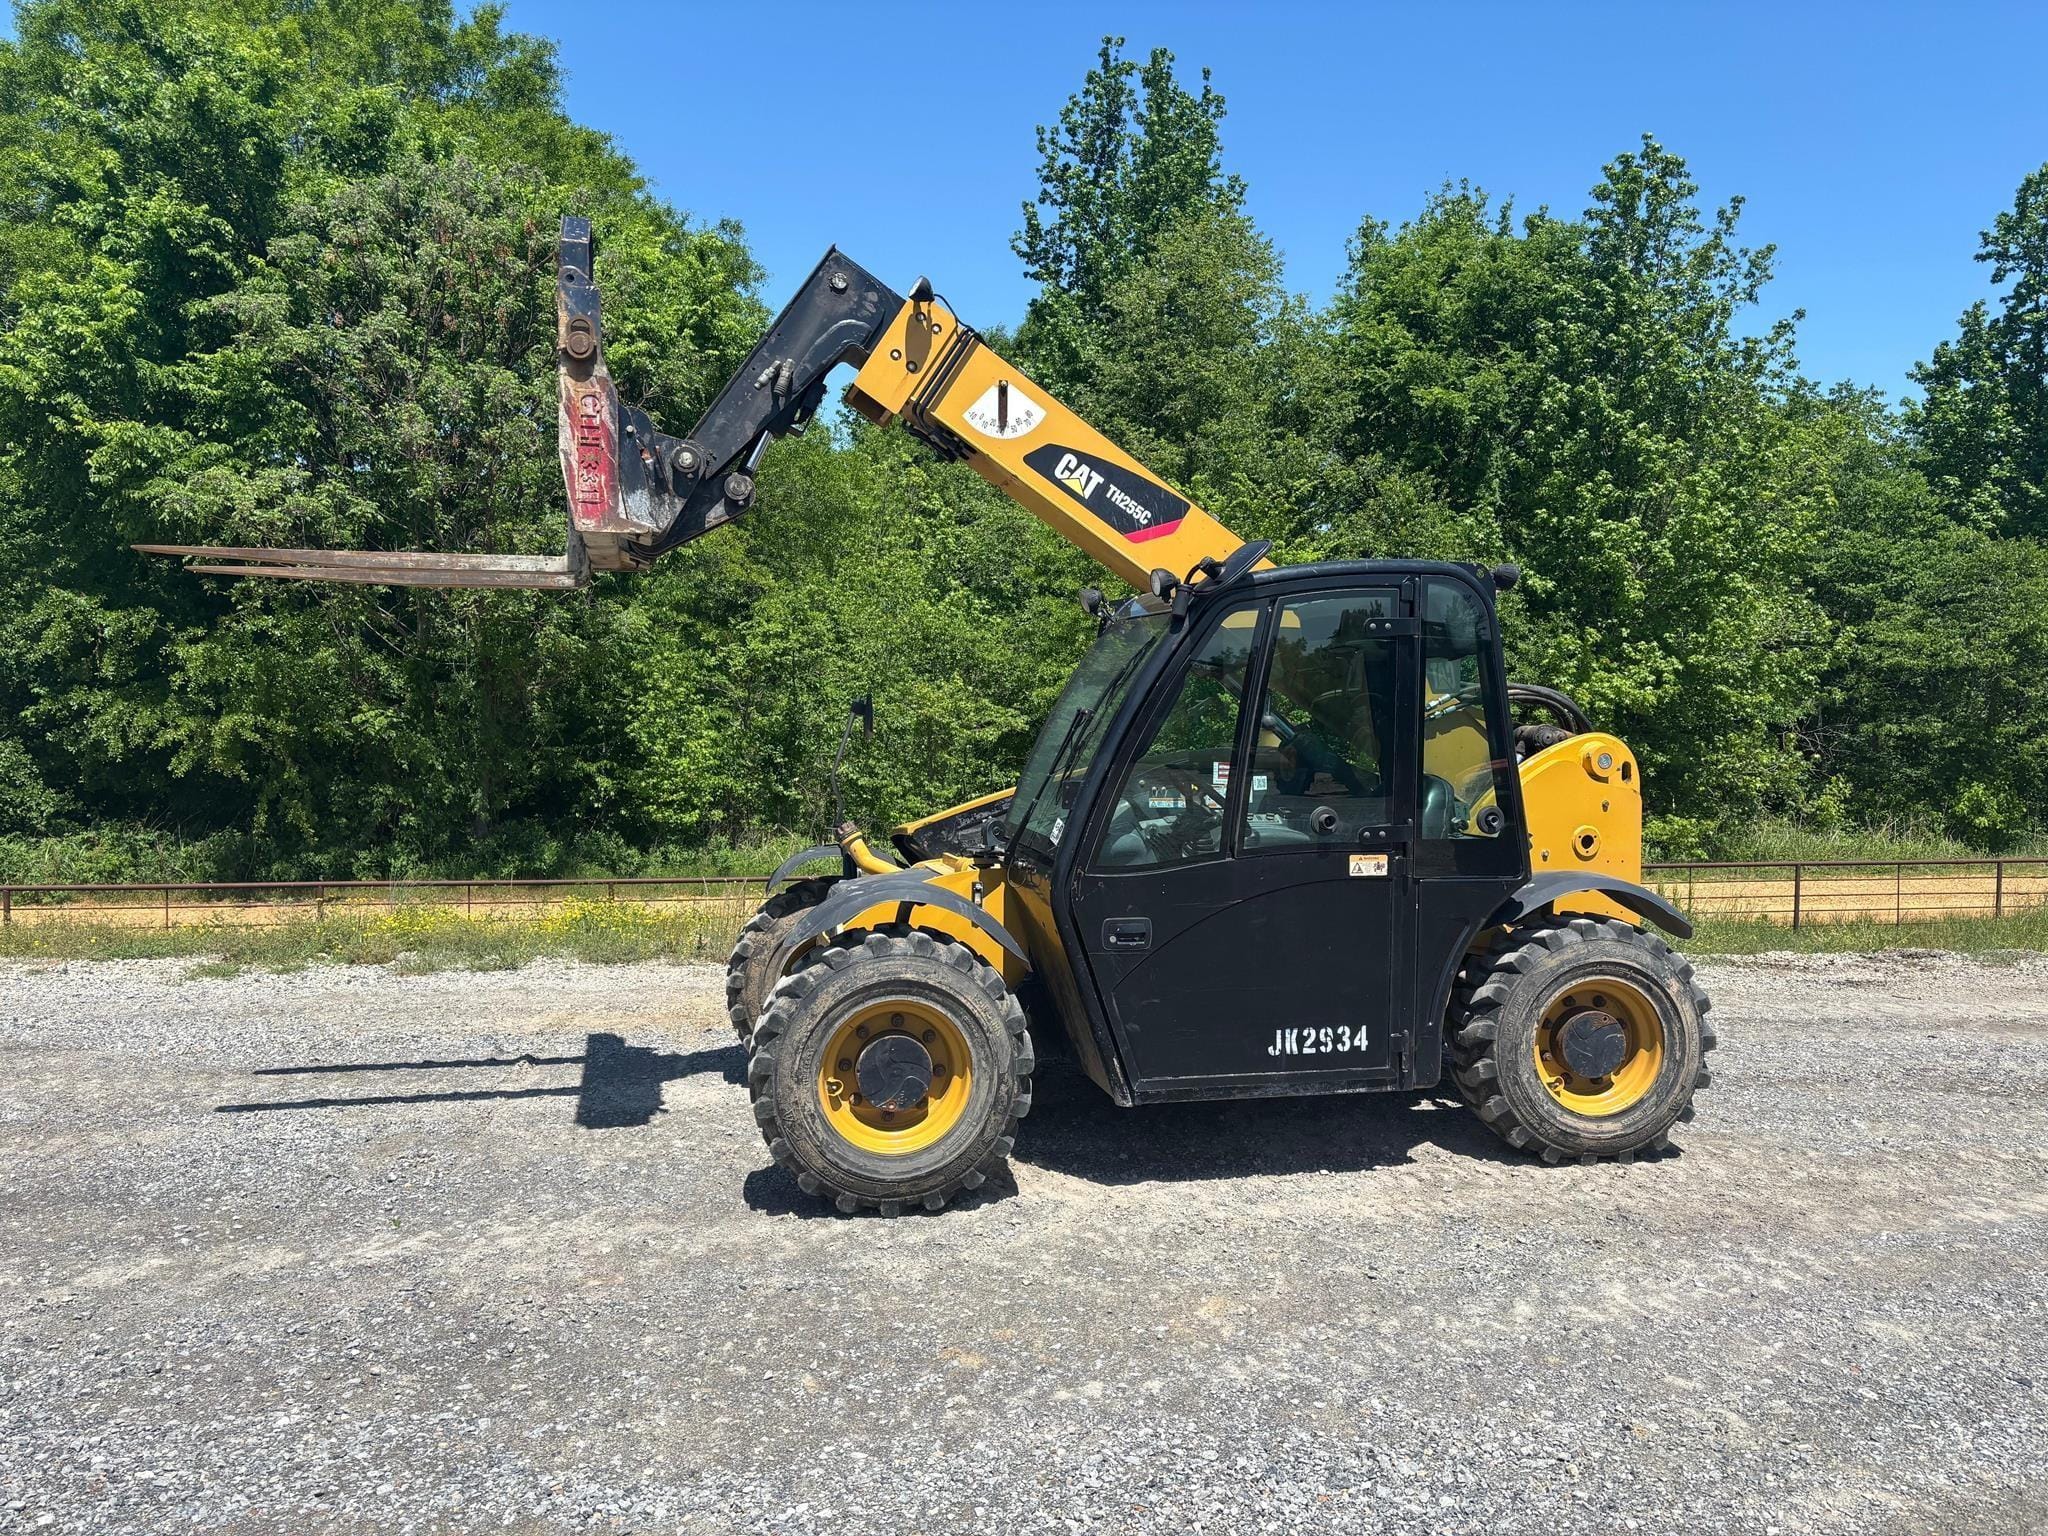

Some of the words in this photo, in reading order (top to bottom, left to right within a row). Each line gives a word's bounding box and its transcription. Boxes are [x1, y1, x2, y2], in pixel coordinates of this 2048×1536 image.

[1054, 452, 1104, 500] CAT
[1105, 483, 1153, 525] TH255C
[1267, 1025, 1369, 1056] JK2934
